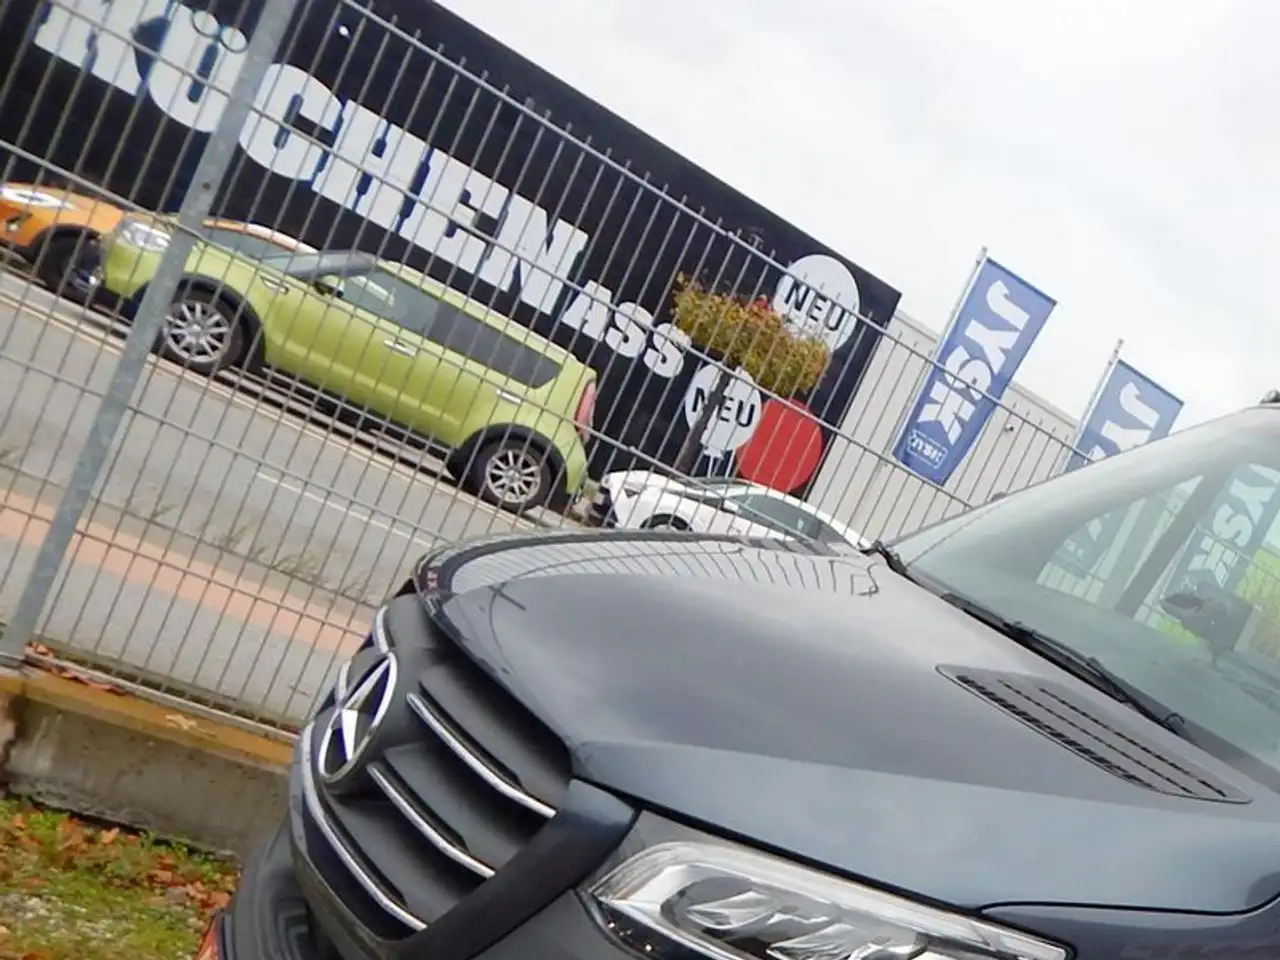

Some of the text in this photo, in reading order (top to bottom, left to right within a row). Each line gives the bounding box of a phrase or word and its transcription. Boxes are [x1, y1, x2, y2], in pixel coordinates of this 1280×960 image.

[784, 281, 849, 332] NEU
[916, 280, 1030, 446] JYSK
[1084, 381, 1161, 462] JY
